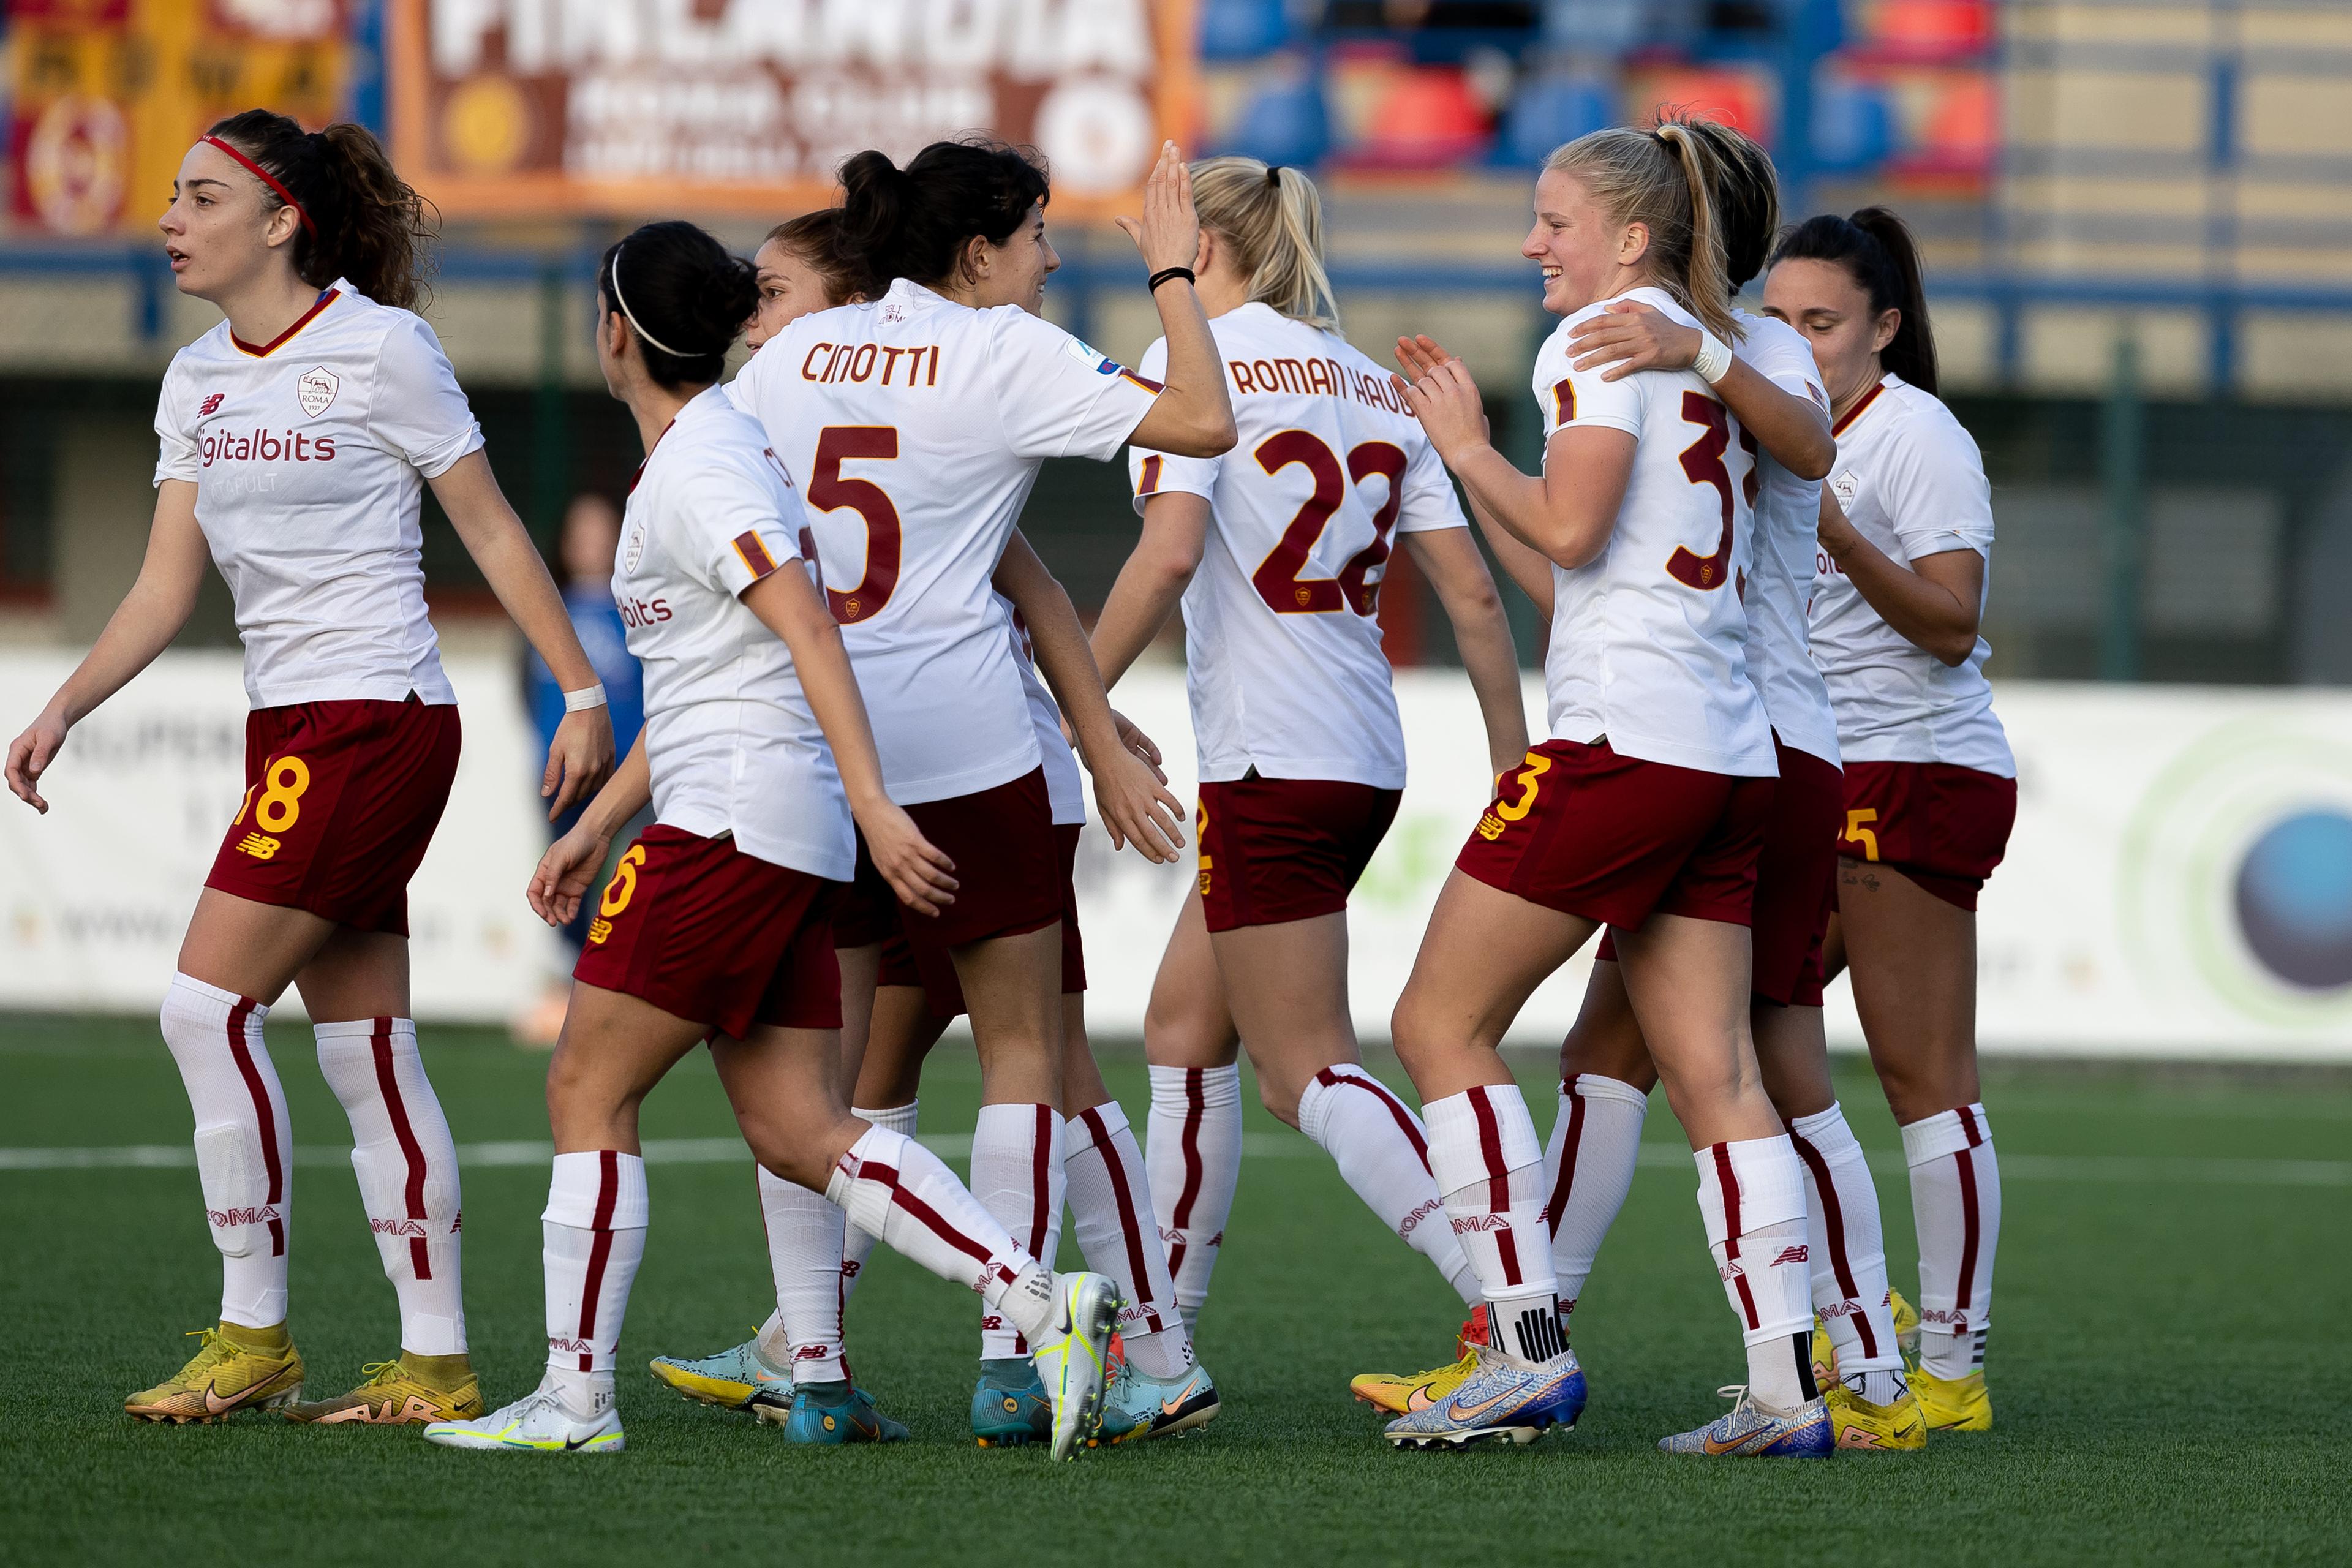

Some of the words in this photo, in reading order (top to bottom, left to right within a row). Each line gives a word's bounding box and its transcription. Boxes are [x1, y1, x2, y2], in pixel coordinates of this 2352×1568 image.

[802, 342, 940, 388] CINOTTI
[1229, 358, 1347, 399] ROMAN
[302, 394, 330, 404] ROMA
[807, 425, 903, 626] 5
[1252, 429, 1408, 617] 22
[234, 755, 311, 834] 18
[206, 1205, 279, 1228] OMA
